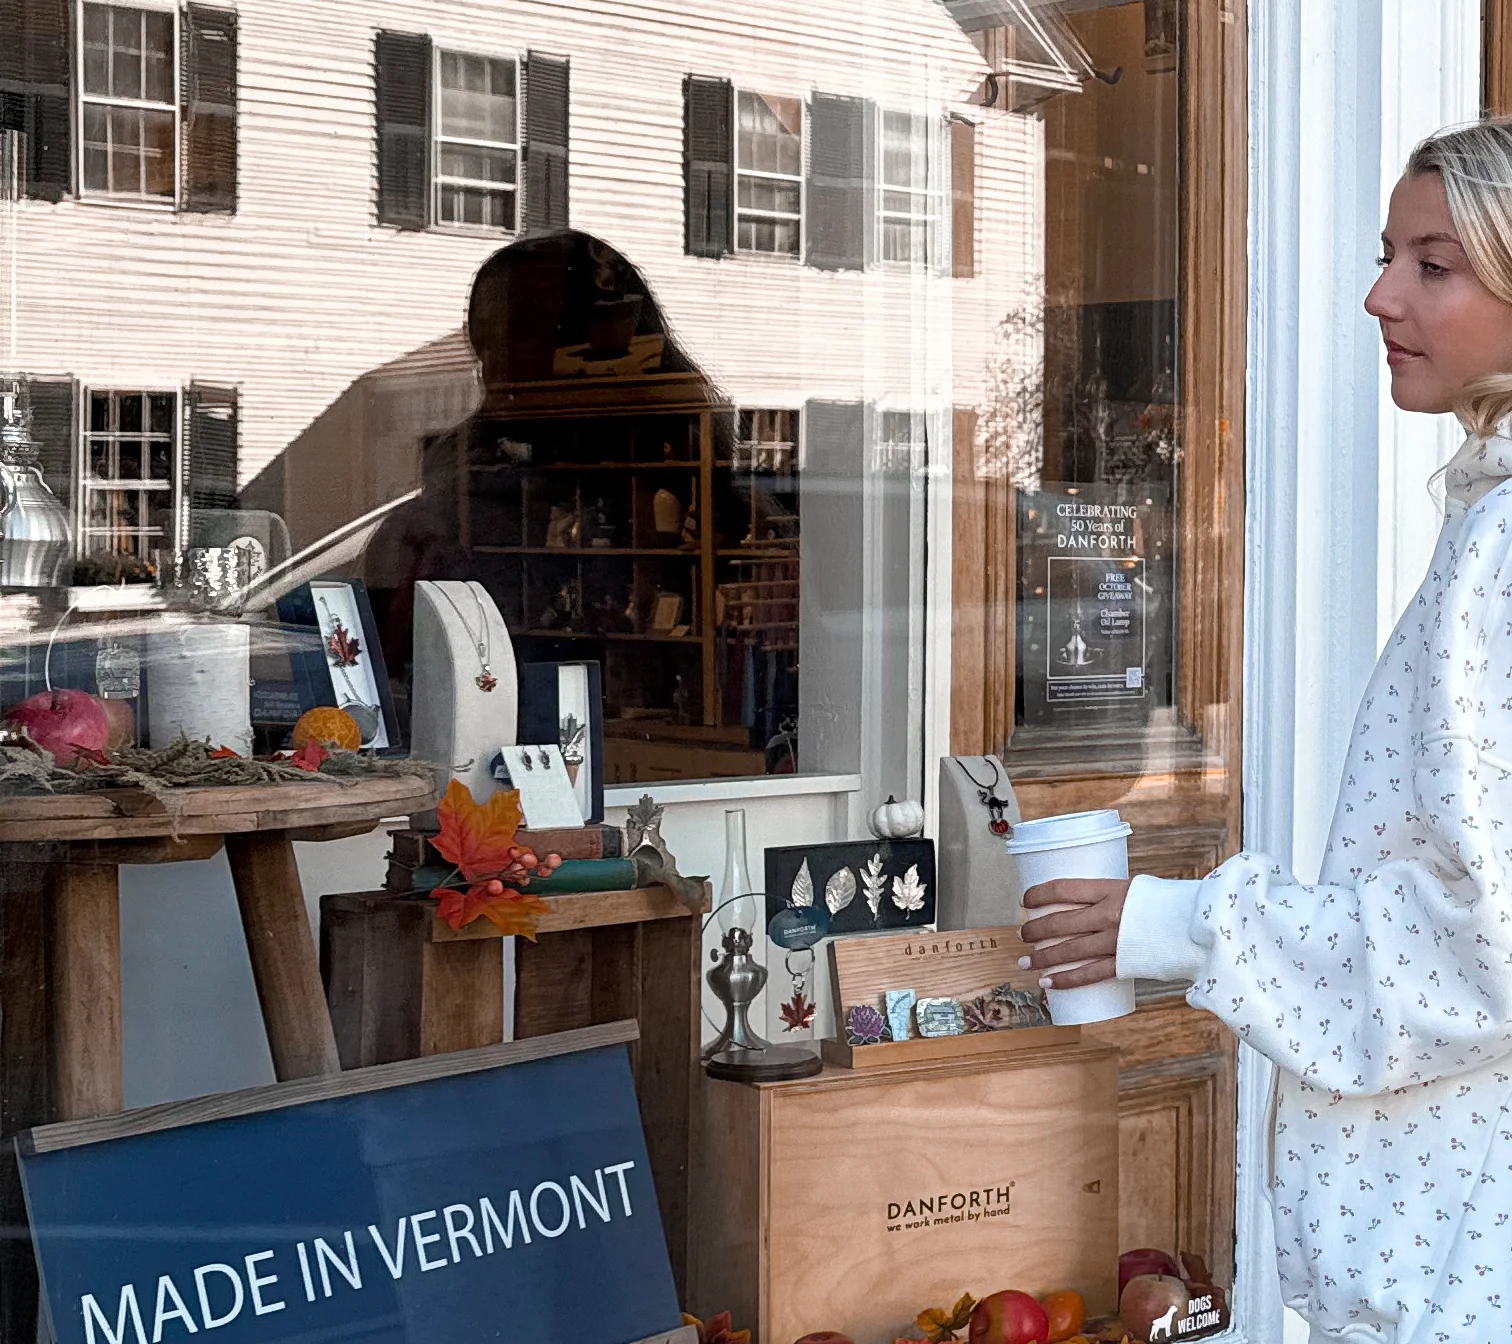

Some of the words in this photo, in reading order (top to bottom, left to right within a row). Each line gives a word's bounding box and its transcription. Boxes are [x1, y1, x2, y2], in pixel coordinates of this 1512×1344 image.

[1057, 504, 1137, 519] CELEBRATING
[1071, 521, 1085, 532] 50
[1086, 521, 1114, 533] Years
[1115, 519, 1125, 532] of
[1057, 534, 1137, 549] DANFORTH
[904, 937, 998, 956] danforth
[886, 1223, 902, 1233] we
[905, 1216, 931, 1231] work
[933, 1210, 965, 1226] metal
[967, 1209, 981, 1222] by
[983, 1203, 1011, 1218] hand
[296, 1229, 363, 1303] IN
[367, 1160, 636, 1280] VERMONT
[1188, 1294, 1213, 1315] DOGS
[1177, 1308, 1221, 1334] WELCOME
